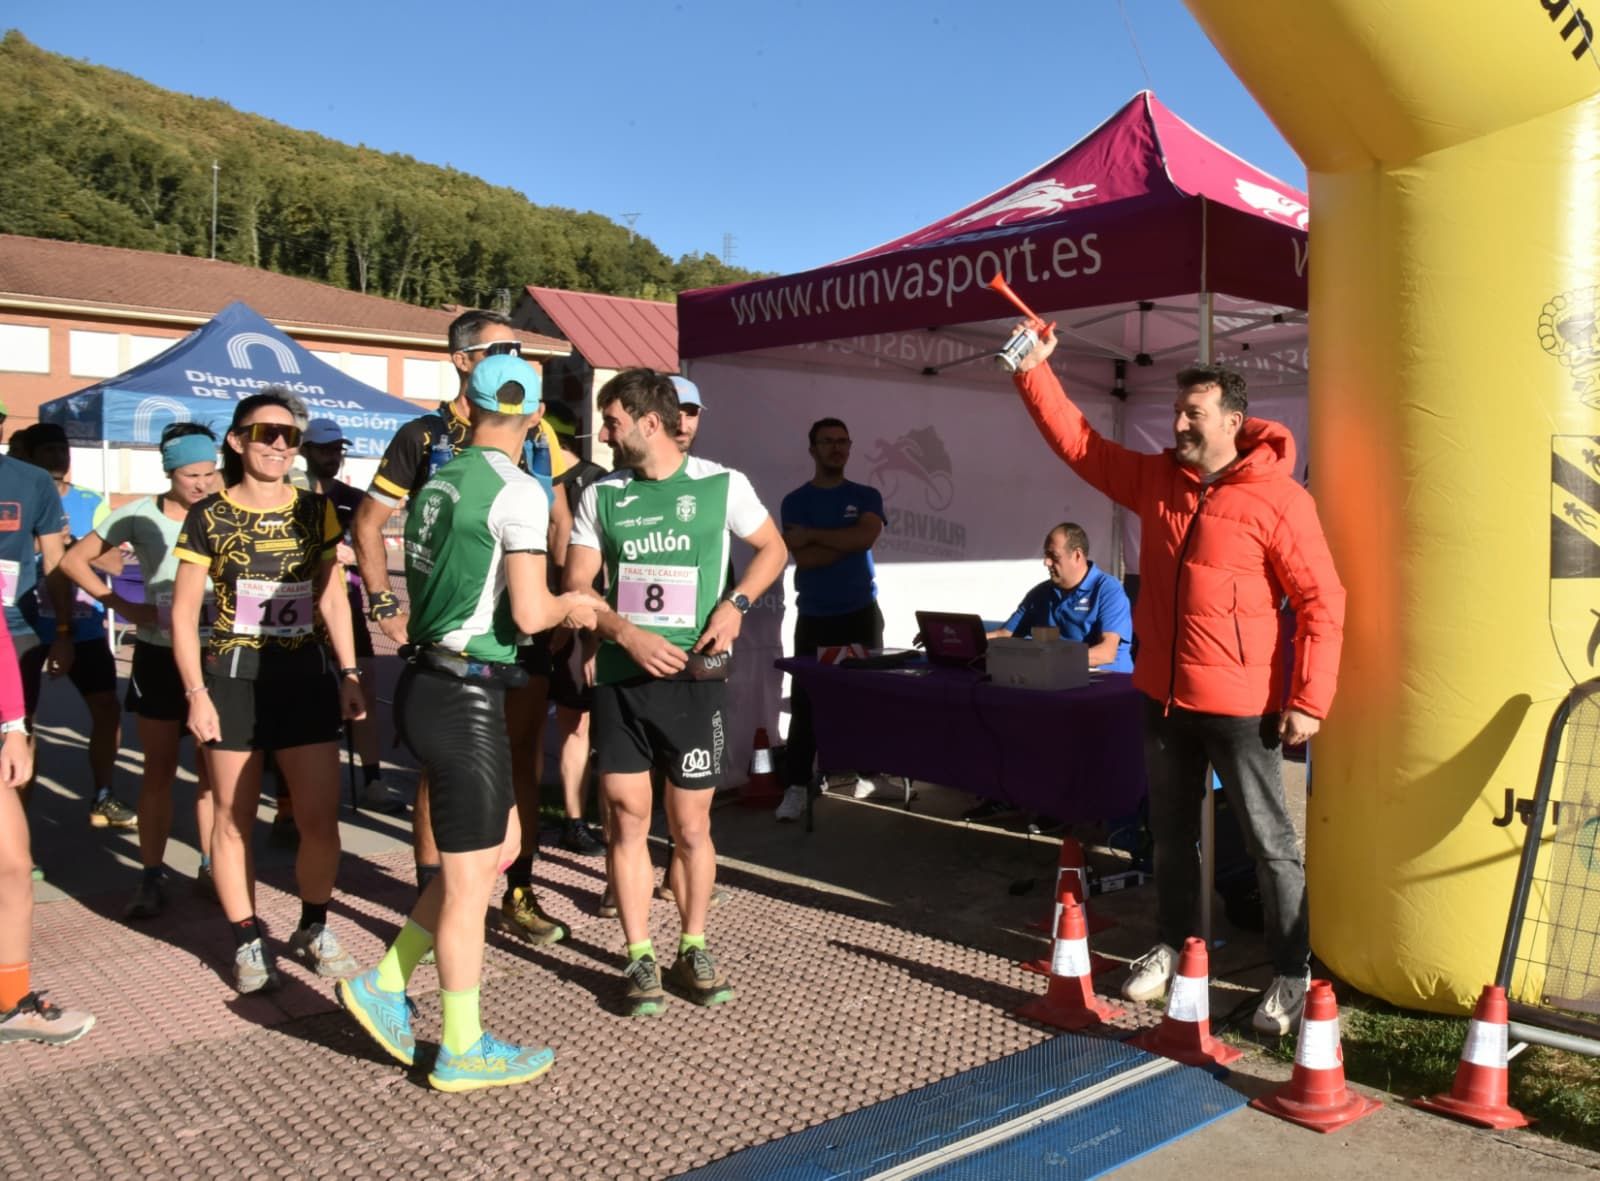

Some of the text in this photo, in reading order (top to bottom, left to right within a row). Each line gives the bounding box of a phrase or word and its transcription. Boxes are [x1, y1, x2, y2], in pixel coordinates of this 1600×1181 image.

[731, 232, 1101, 326] www.runvasport.es
[192, 386, 365, 410] DE PNCIA
[623, 528, 691, 560] gullón
[258, 599, 298, 626] 16
[644, 584, 664, 613] 8
